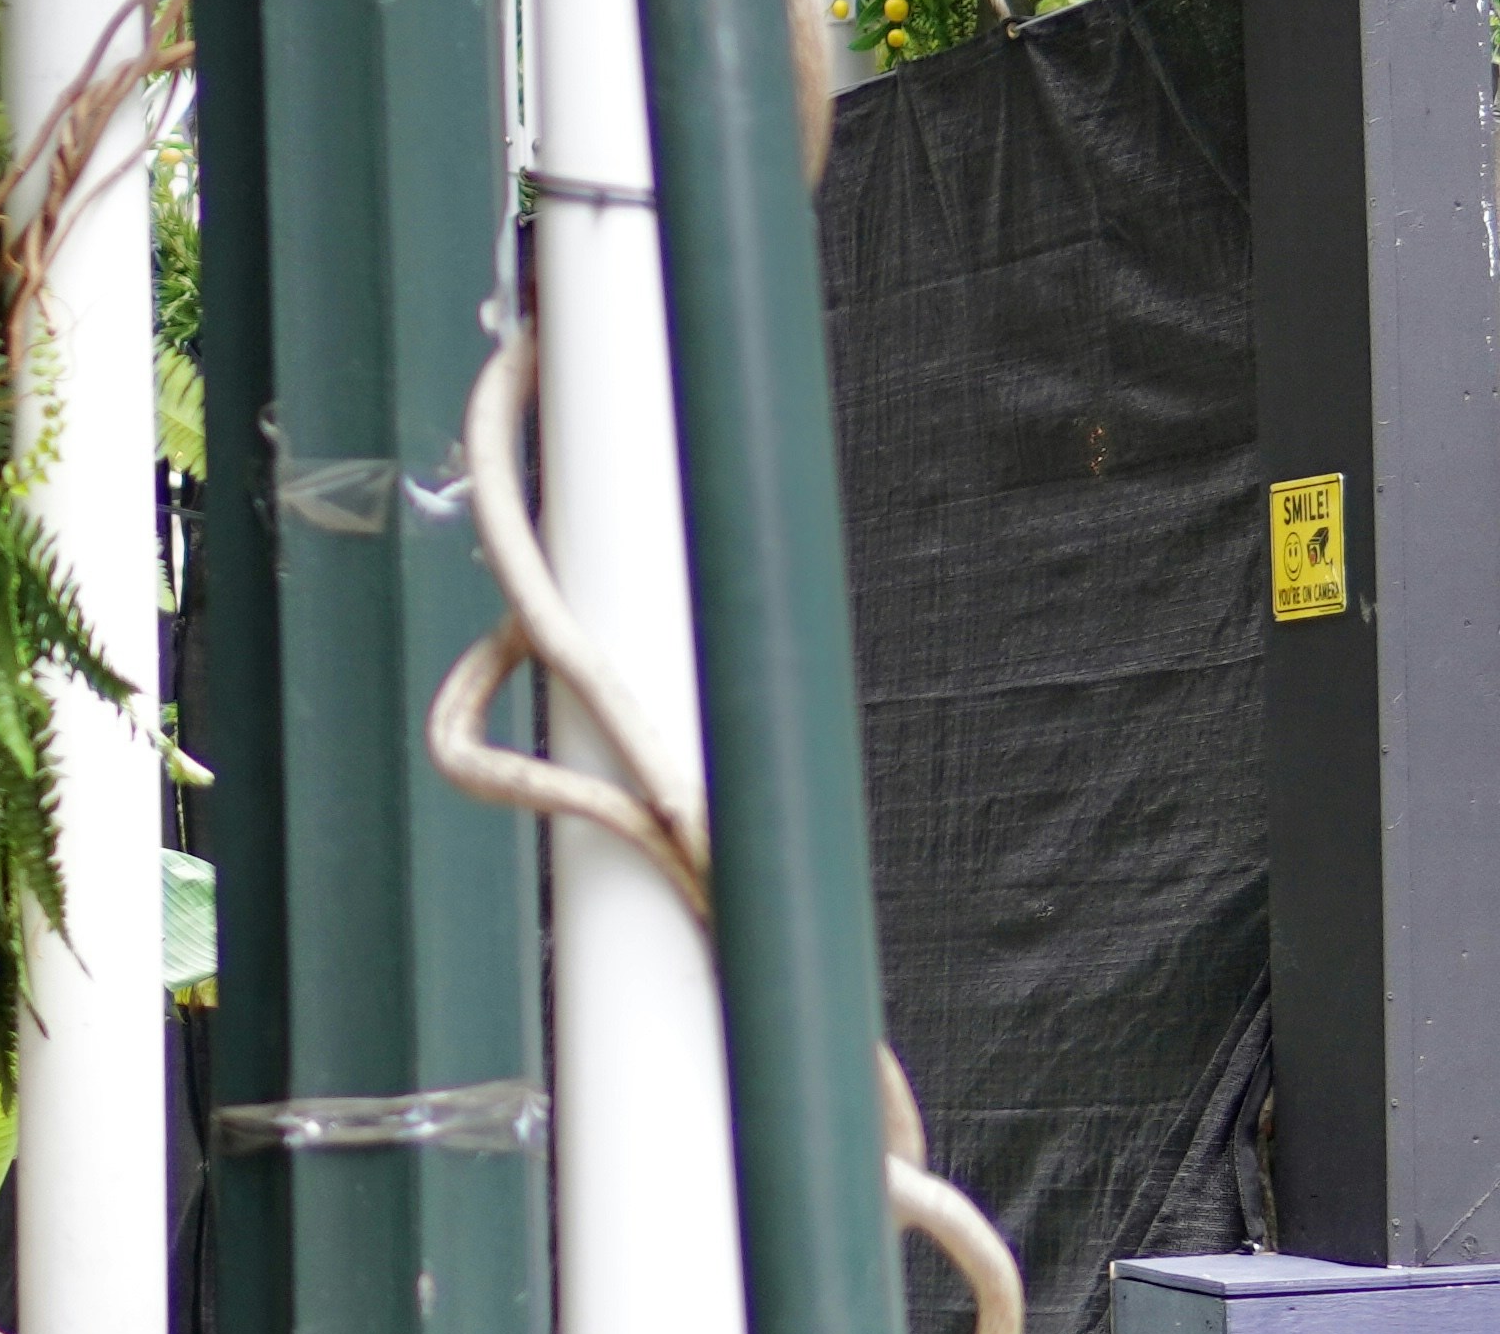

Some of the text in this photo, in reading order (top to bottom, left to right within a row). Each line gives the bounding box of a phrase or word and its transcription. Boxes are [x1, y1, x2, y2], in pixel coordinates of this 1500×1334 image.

[1284, 488, 1329, 525] SMILE!
[1278, 581, 1340, 607] YOU'RE ON CAMERA
